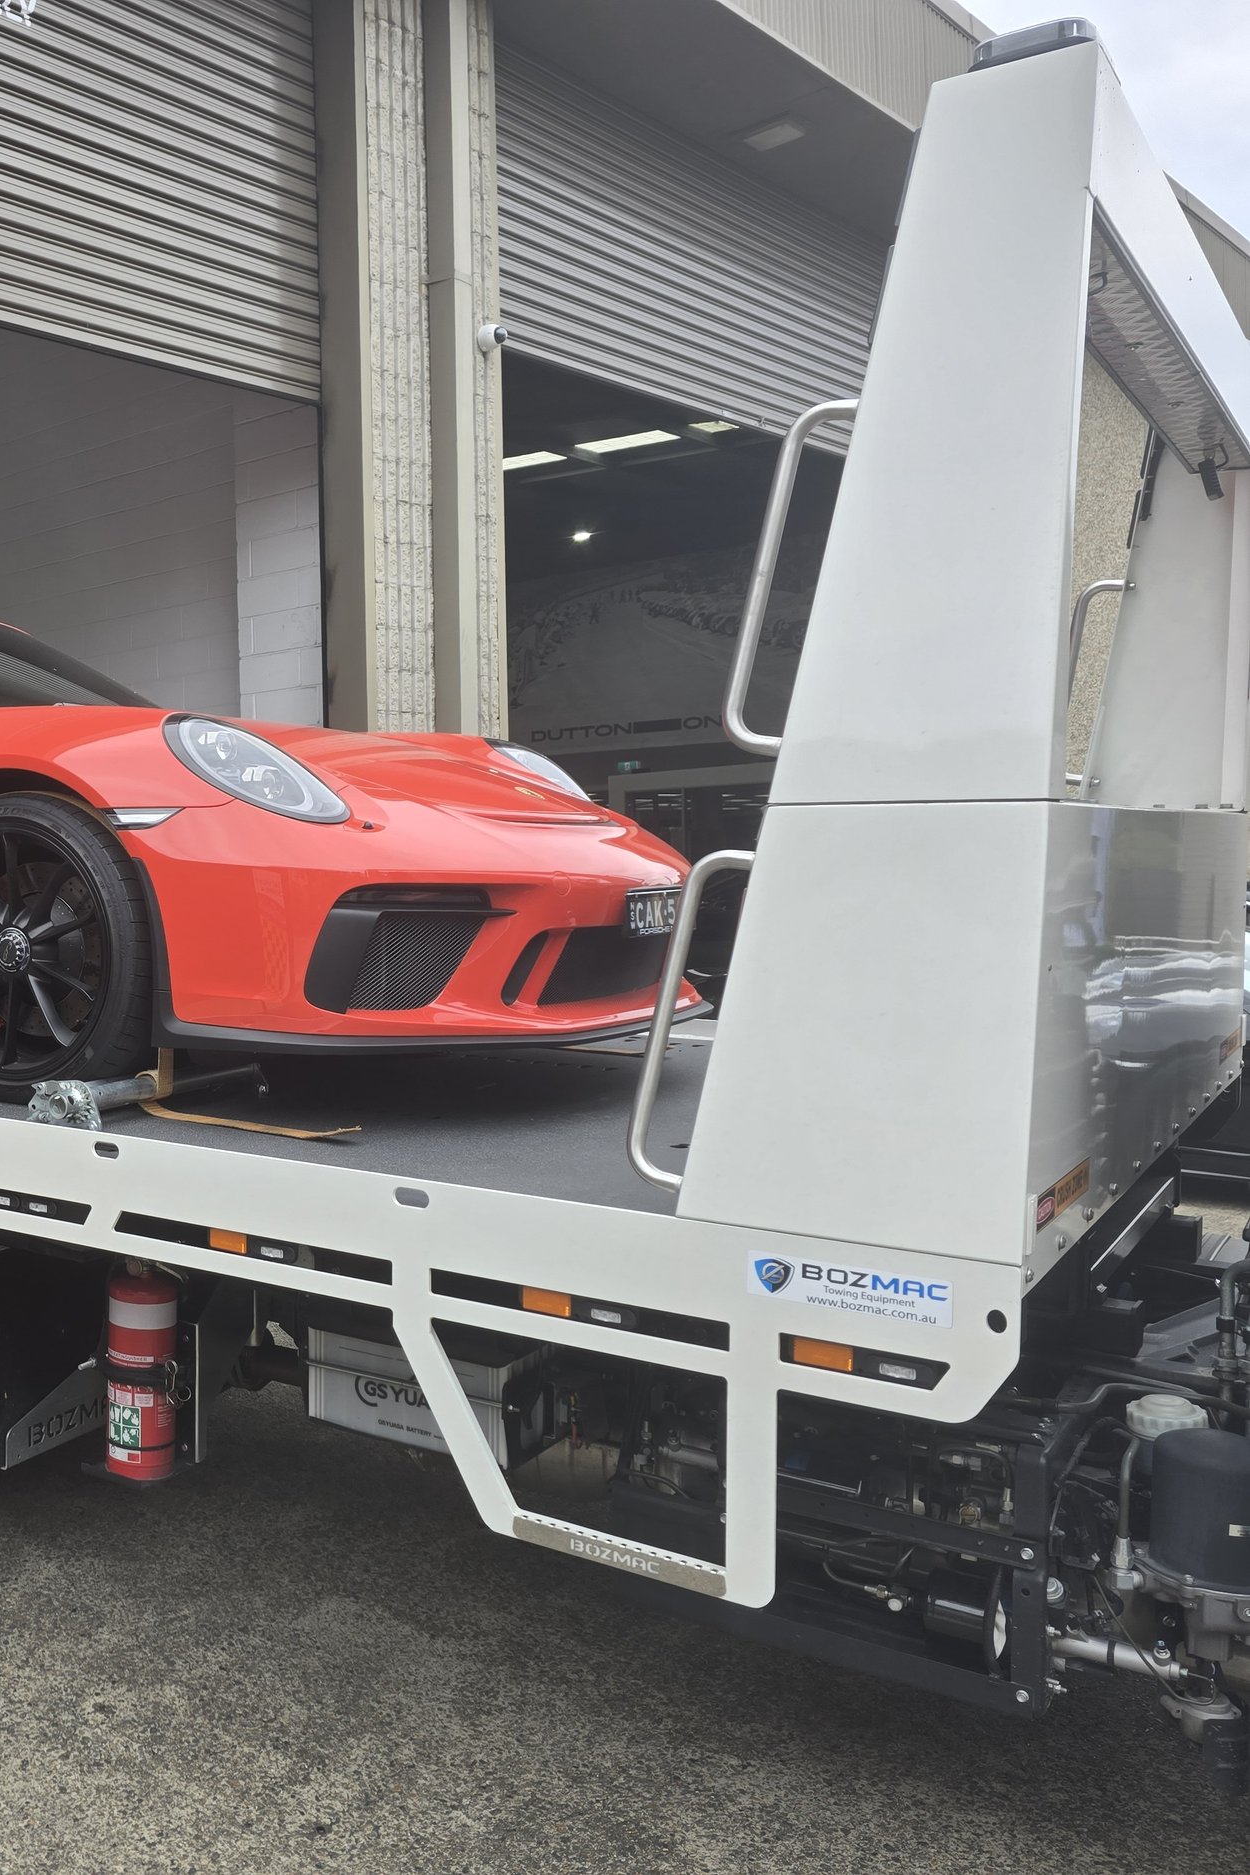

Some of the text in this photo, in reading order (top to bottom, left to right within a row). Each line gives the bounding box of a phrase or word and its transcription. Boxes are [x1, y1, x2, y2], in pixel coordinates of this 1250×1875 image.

[531, 722, 632, 742] DUTTON
[801, 1262, 950, 1302] BOZMAC
[823, 1285, 916, 1309] Towing Equipment
[806, 1294, 937, 1325] www.bozmac.com.au
[569, 1537, 661, 1575] BOZMAC
